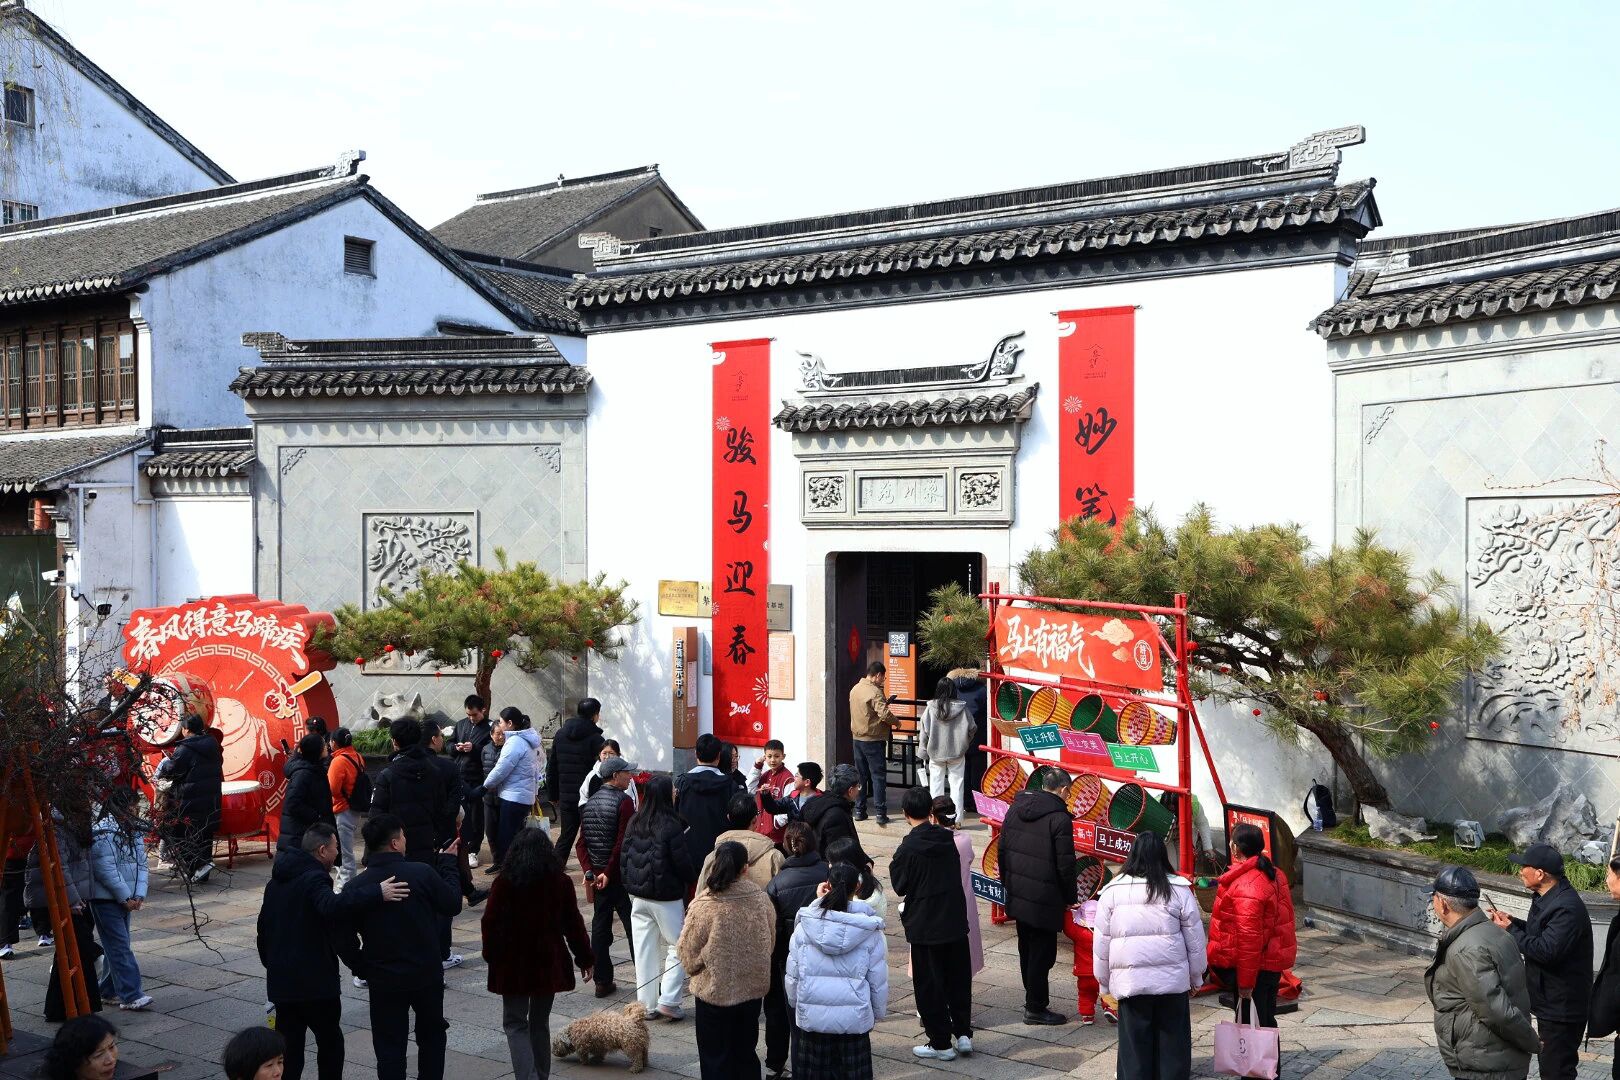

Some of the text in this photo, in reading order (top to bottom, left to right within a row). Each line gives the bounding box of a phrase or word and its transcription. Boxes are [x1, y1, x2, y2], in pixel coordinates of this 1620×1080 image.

[723, 426, 757, 667] 骏马迎春
[129, 602, 307, 670] 春风得意马蹄疾
[999, 613, 1096, 680] 马上有福气
[728, 701, 752, 717] 2026
[1024, 731, 1058, 745] 马上升职
[1066, 736, 1100, 751] 马上变美
[1113, 750, 1150, 765] 马上开心
[1098, 832, 1132, 853] 马上成功
[974, 879, 1002, 899] 马上有财
